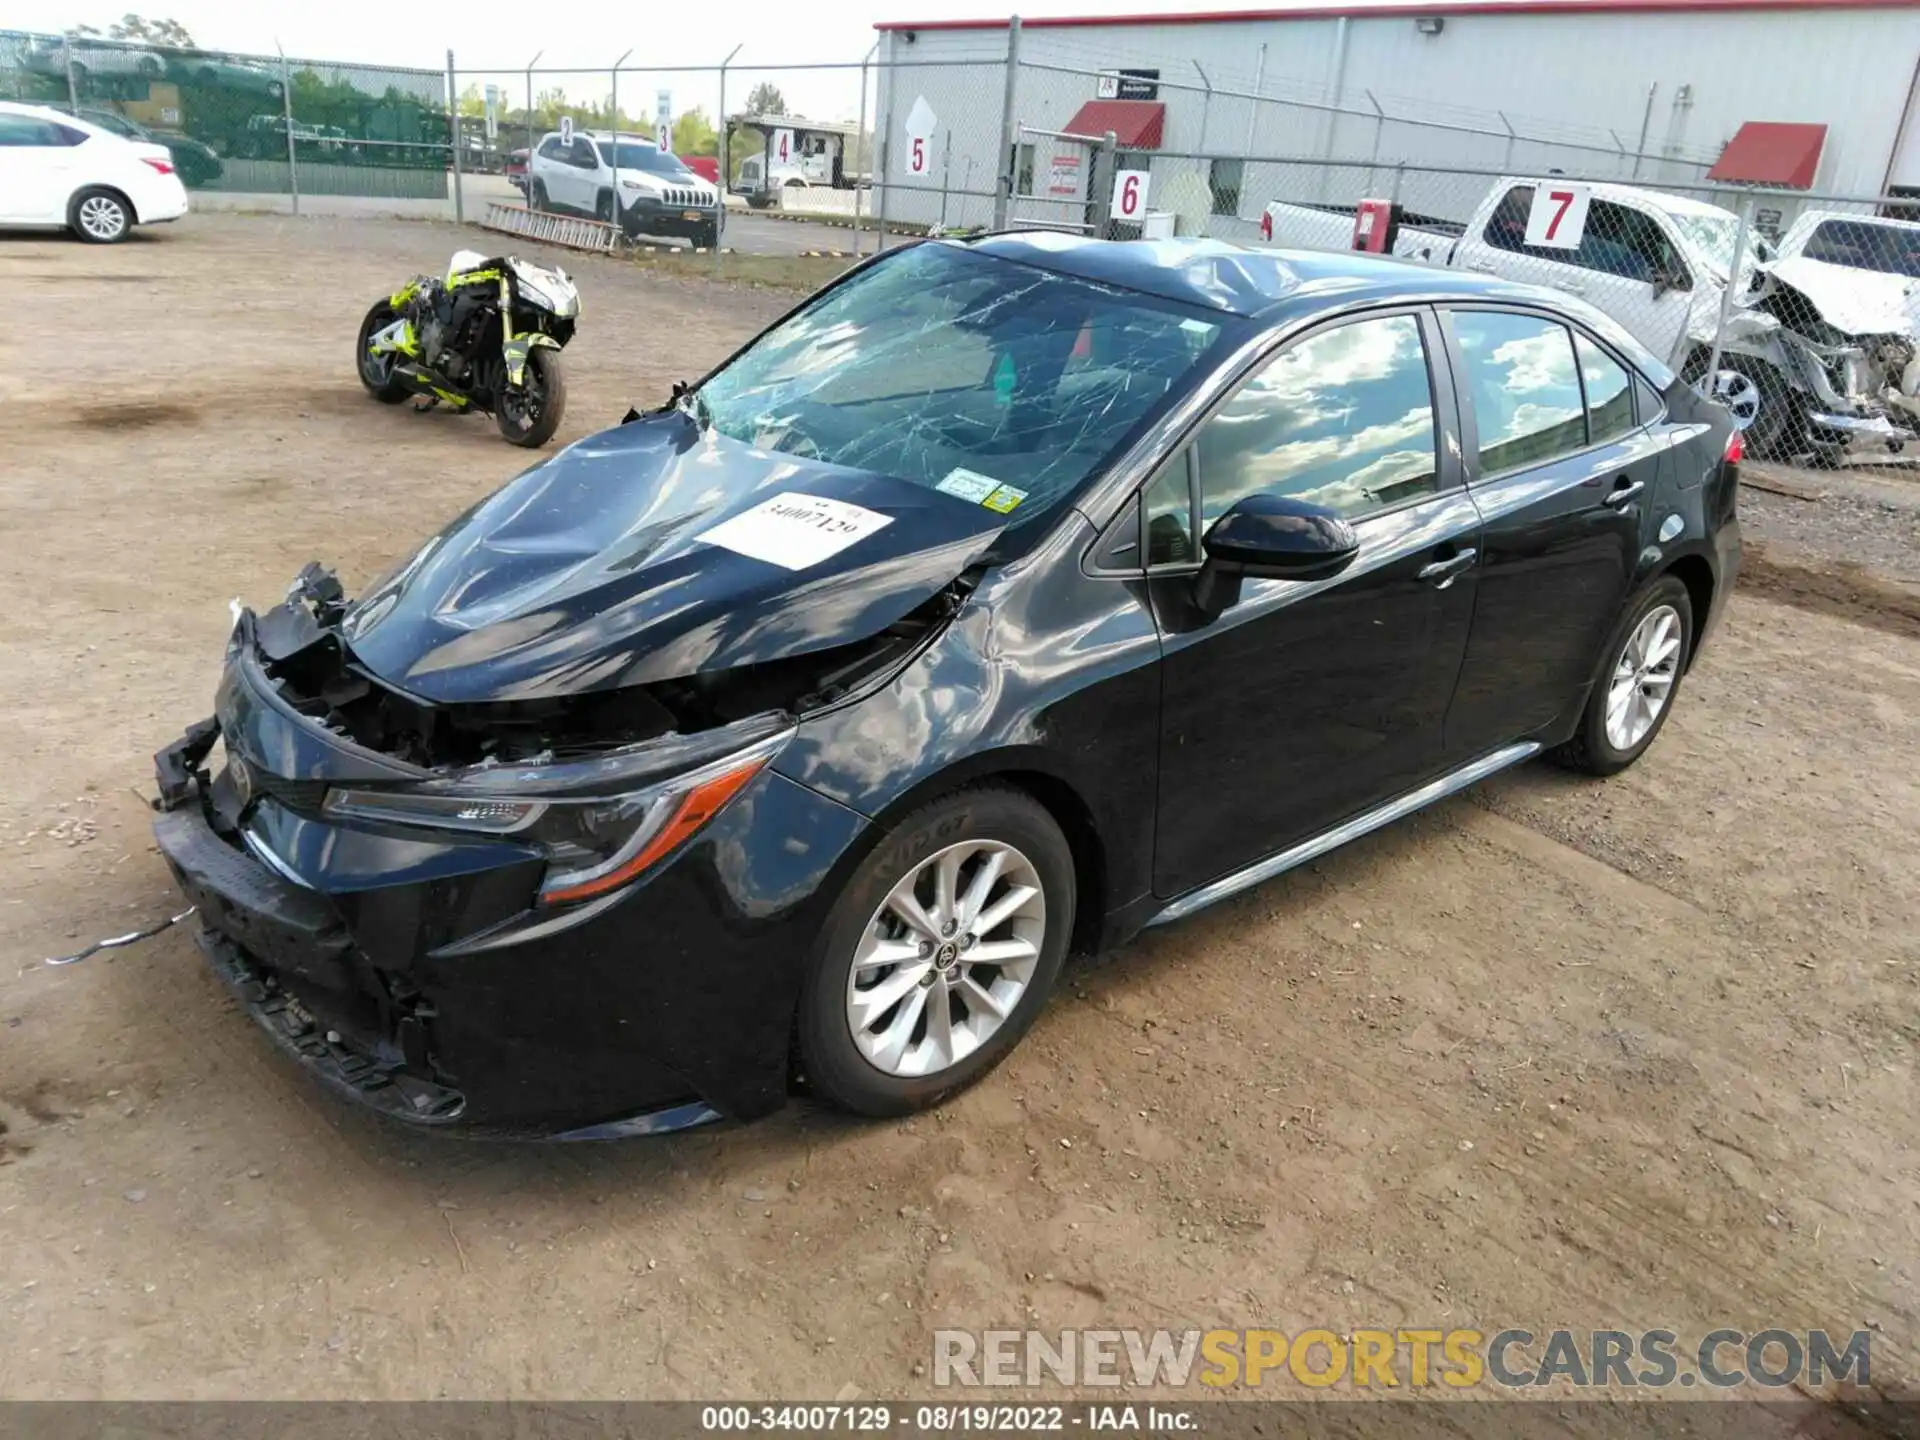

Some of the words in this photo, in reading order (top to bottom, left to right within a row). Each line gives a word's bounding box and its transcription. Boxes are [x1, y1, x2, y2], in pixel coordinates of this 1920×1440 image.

[659, 125, 668, 152] 3
[779, 132, 789, 163] 4
[912, 137, 924, 172] 5
[1121, 175, 1140, 215] 6
[1545, 191, 1575, 241] 7
